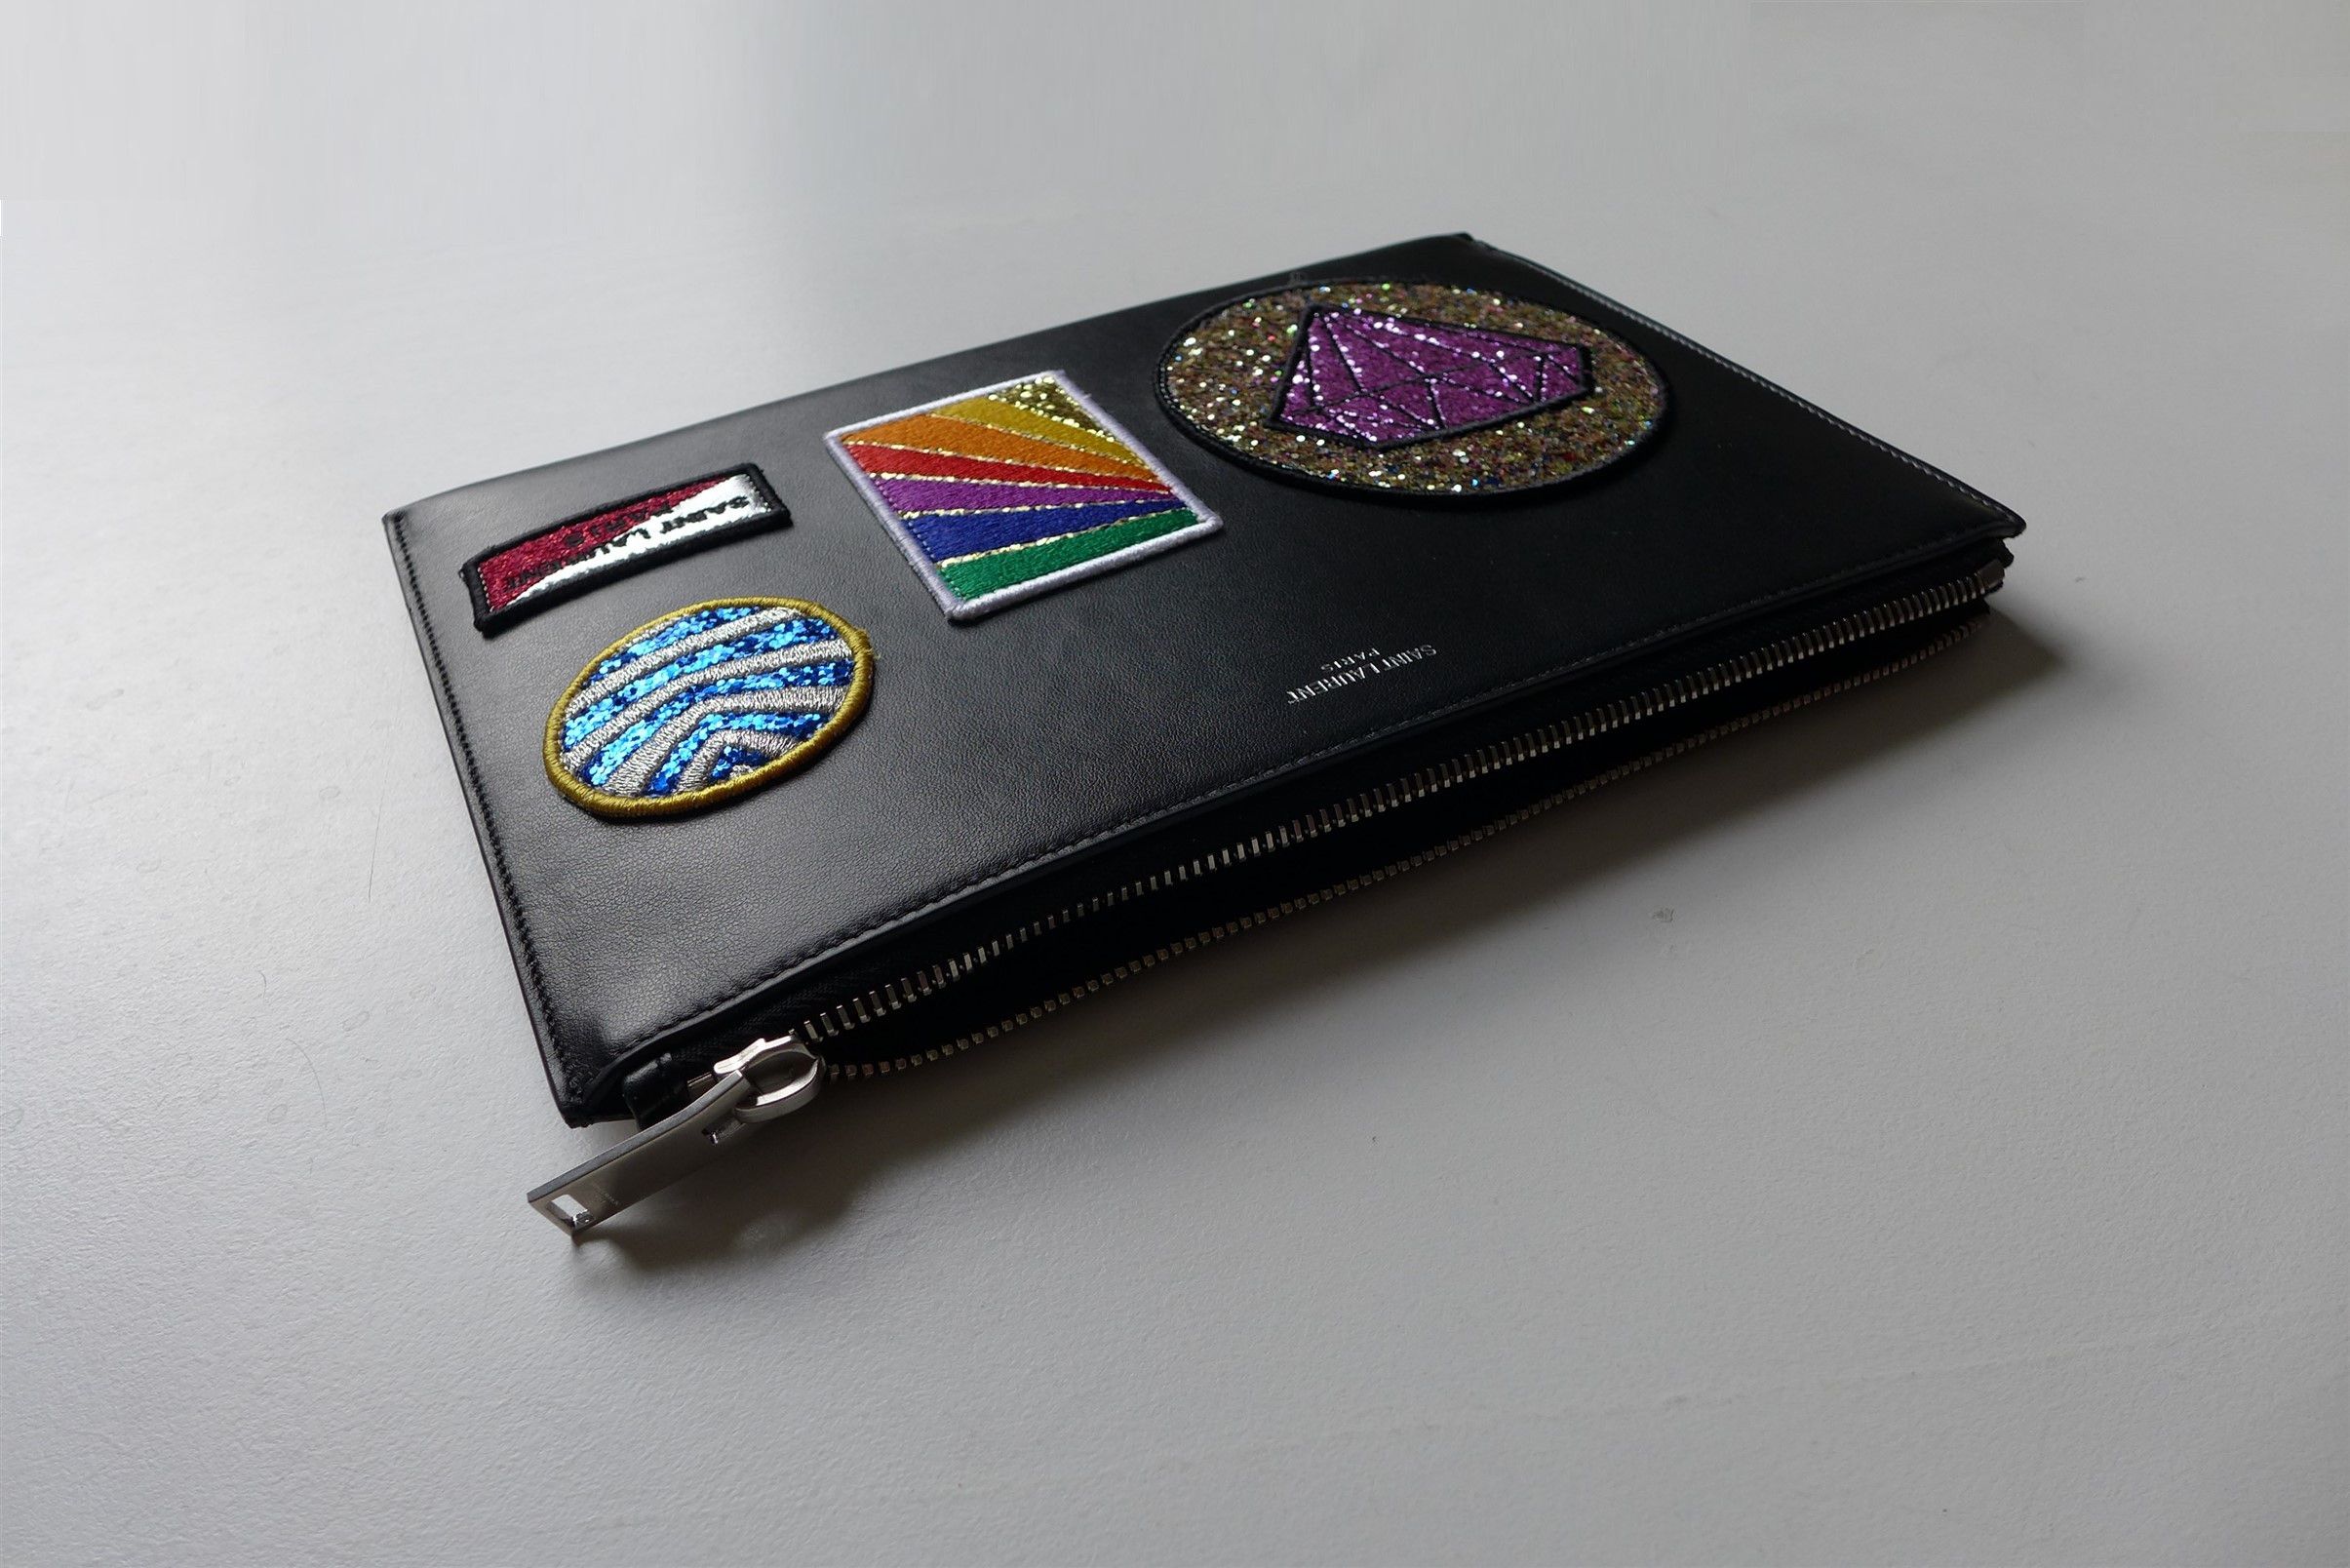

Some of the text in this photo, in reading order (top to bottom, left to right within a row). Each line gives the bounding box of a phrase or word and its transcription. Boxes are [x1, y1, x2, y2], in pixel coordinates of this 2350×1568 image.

[507, 495, 750, 588] SAINT LAURENT
[1286, 645, 1437, 704] SAINT LAURENT
[1321, 647, 1380, 671] PARIS
